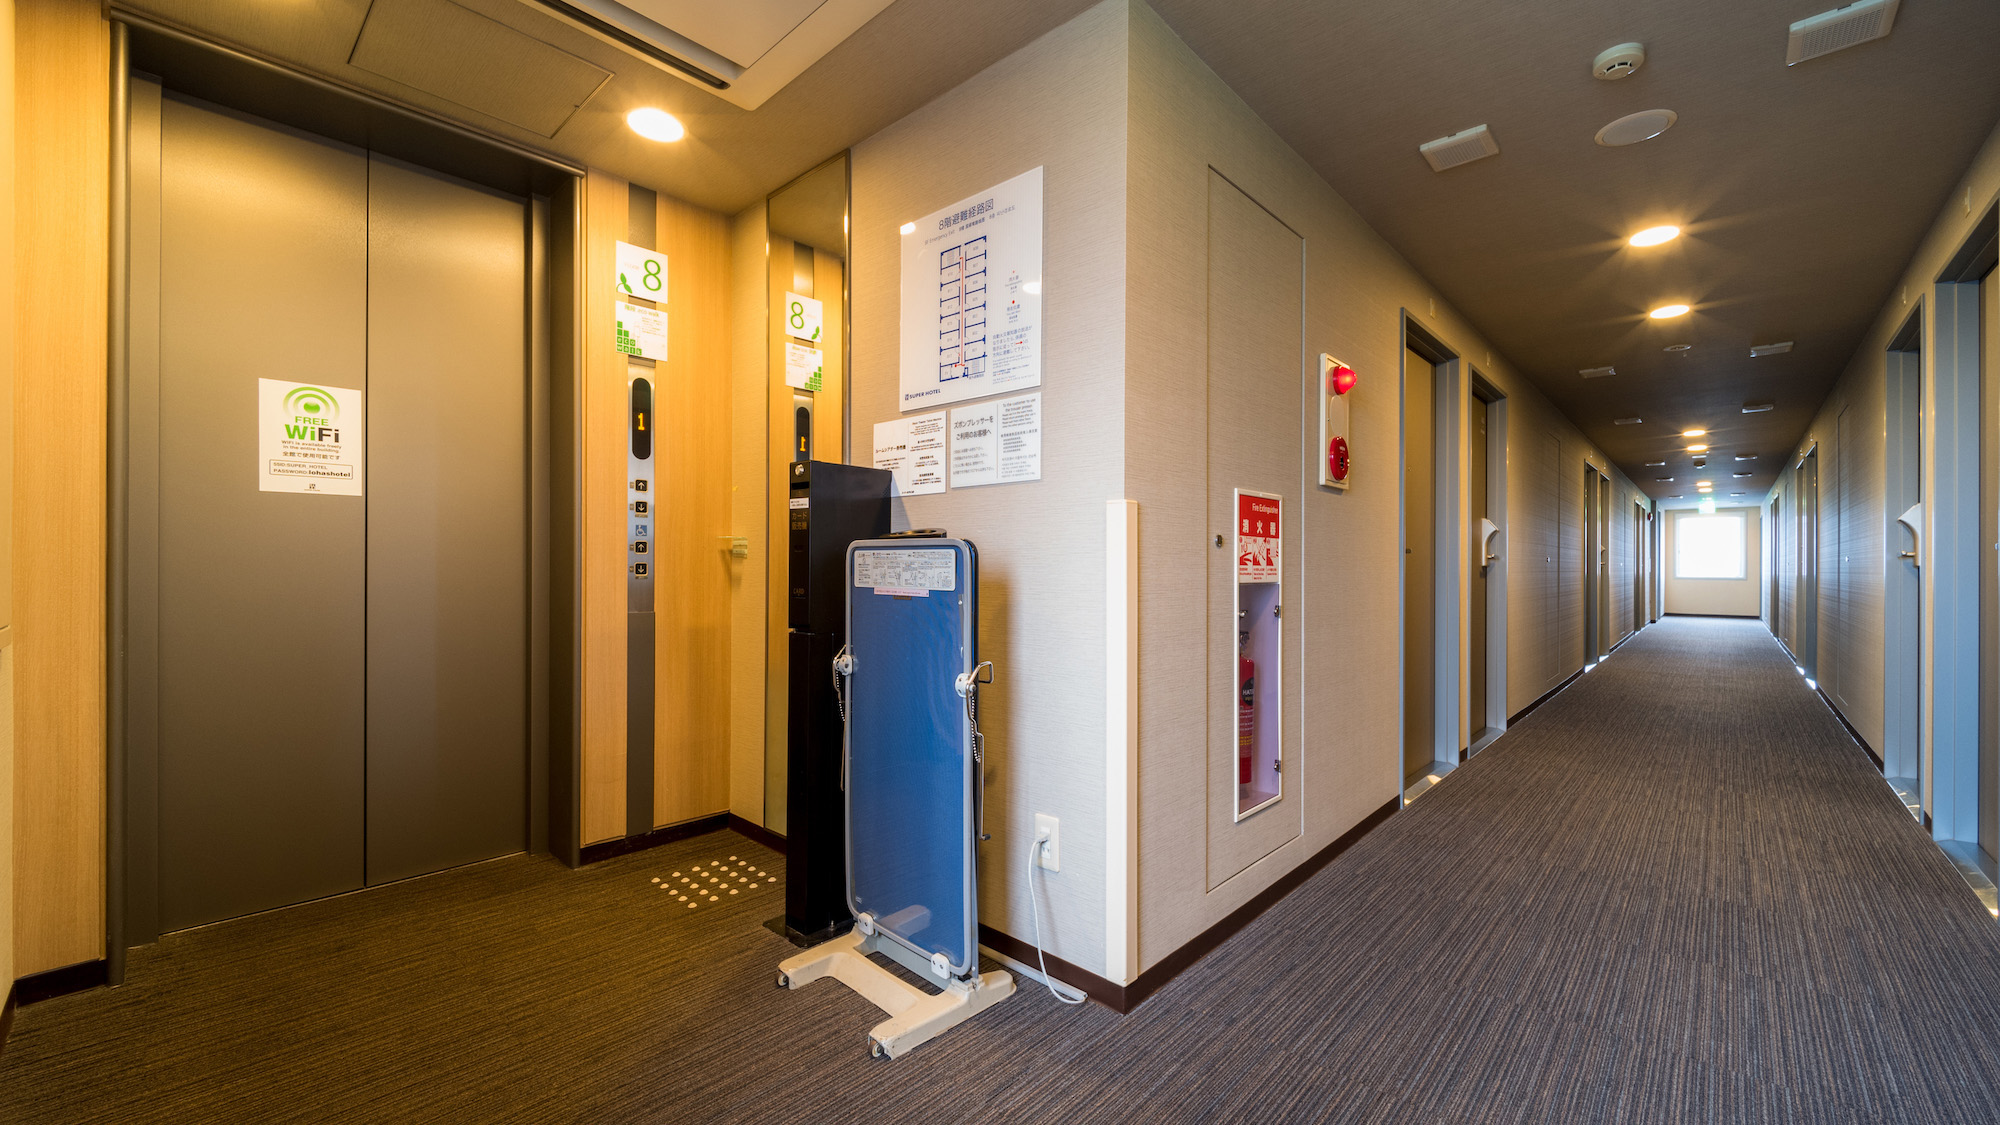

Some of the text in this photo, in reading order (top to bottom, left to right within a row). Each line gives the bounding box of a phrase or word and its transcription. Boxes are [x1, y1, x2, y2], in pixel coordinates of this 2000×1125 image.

[642, 259, 662, 291] 8
[617, 337, 635, 346] eco
[294, 416, 329, 426] FREE
[638, 413, 646, 430] 1
[284, 424, 340, 443] WiFi
[956, 429, 992, 440] ご利用のお客様へ
[282, 451, 340, 460] 全館で使用可能です
